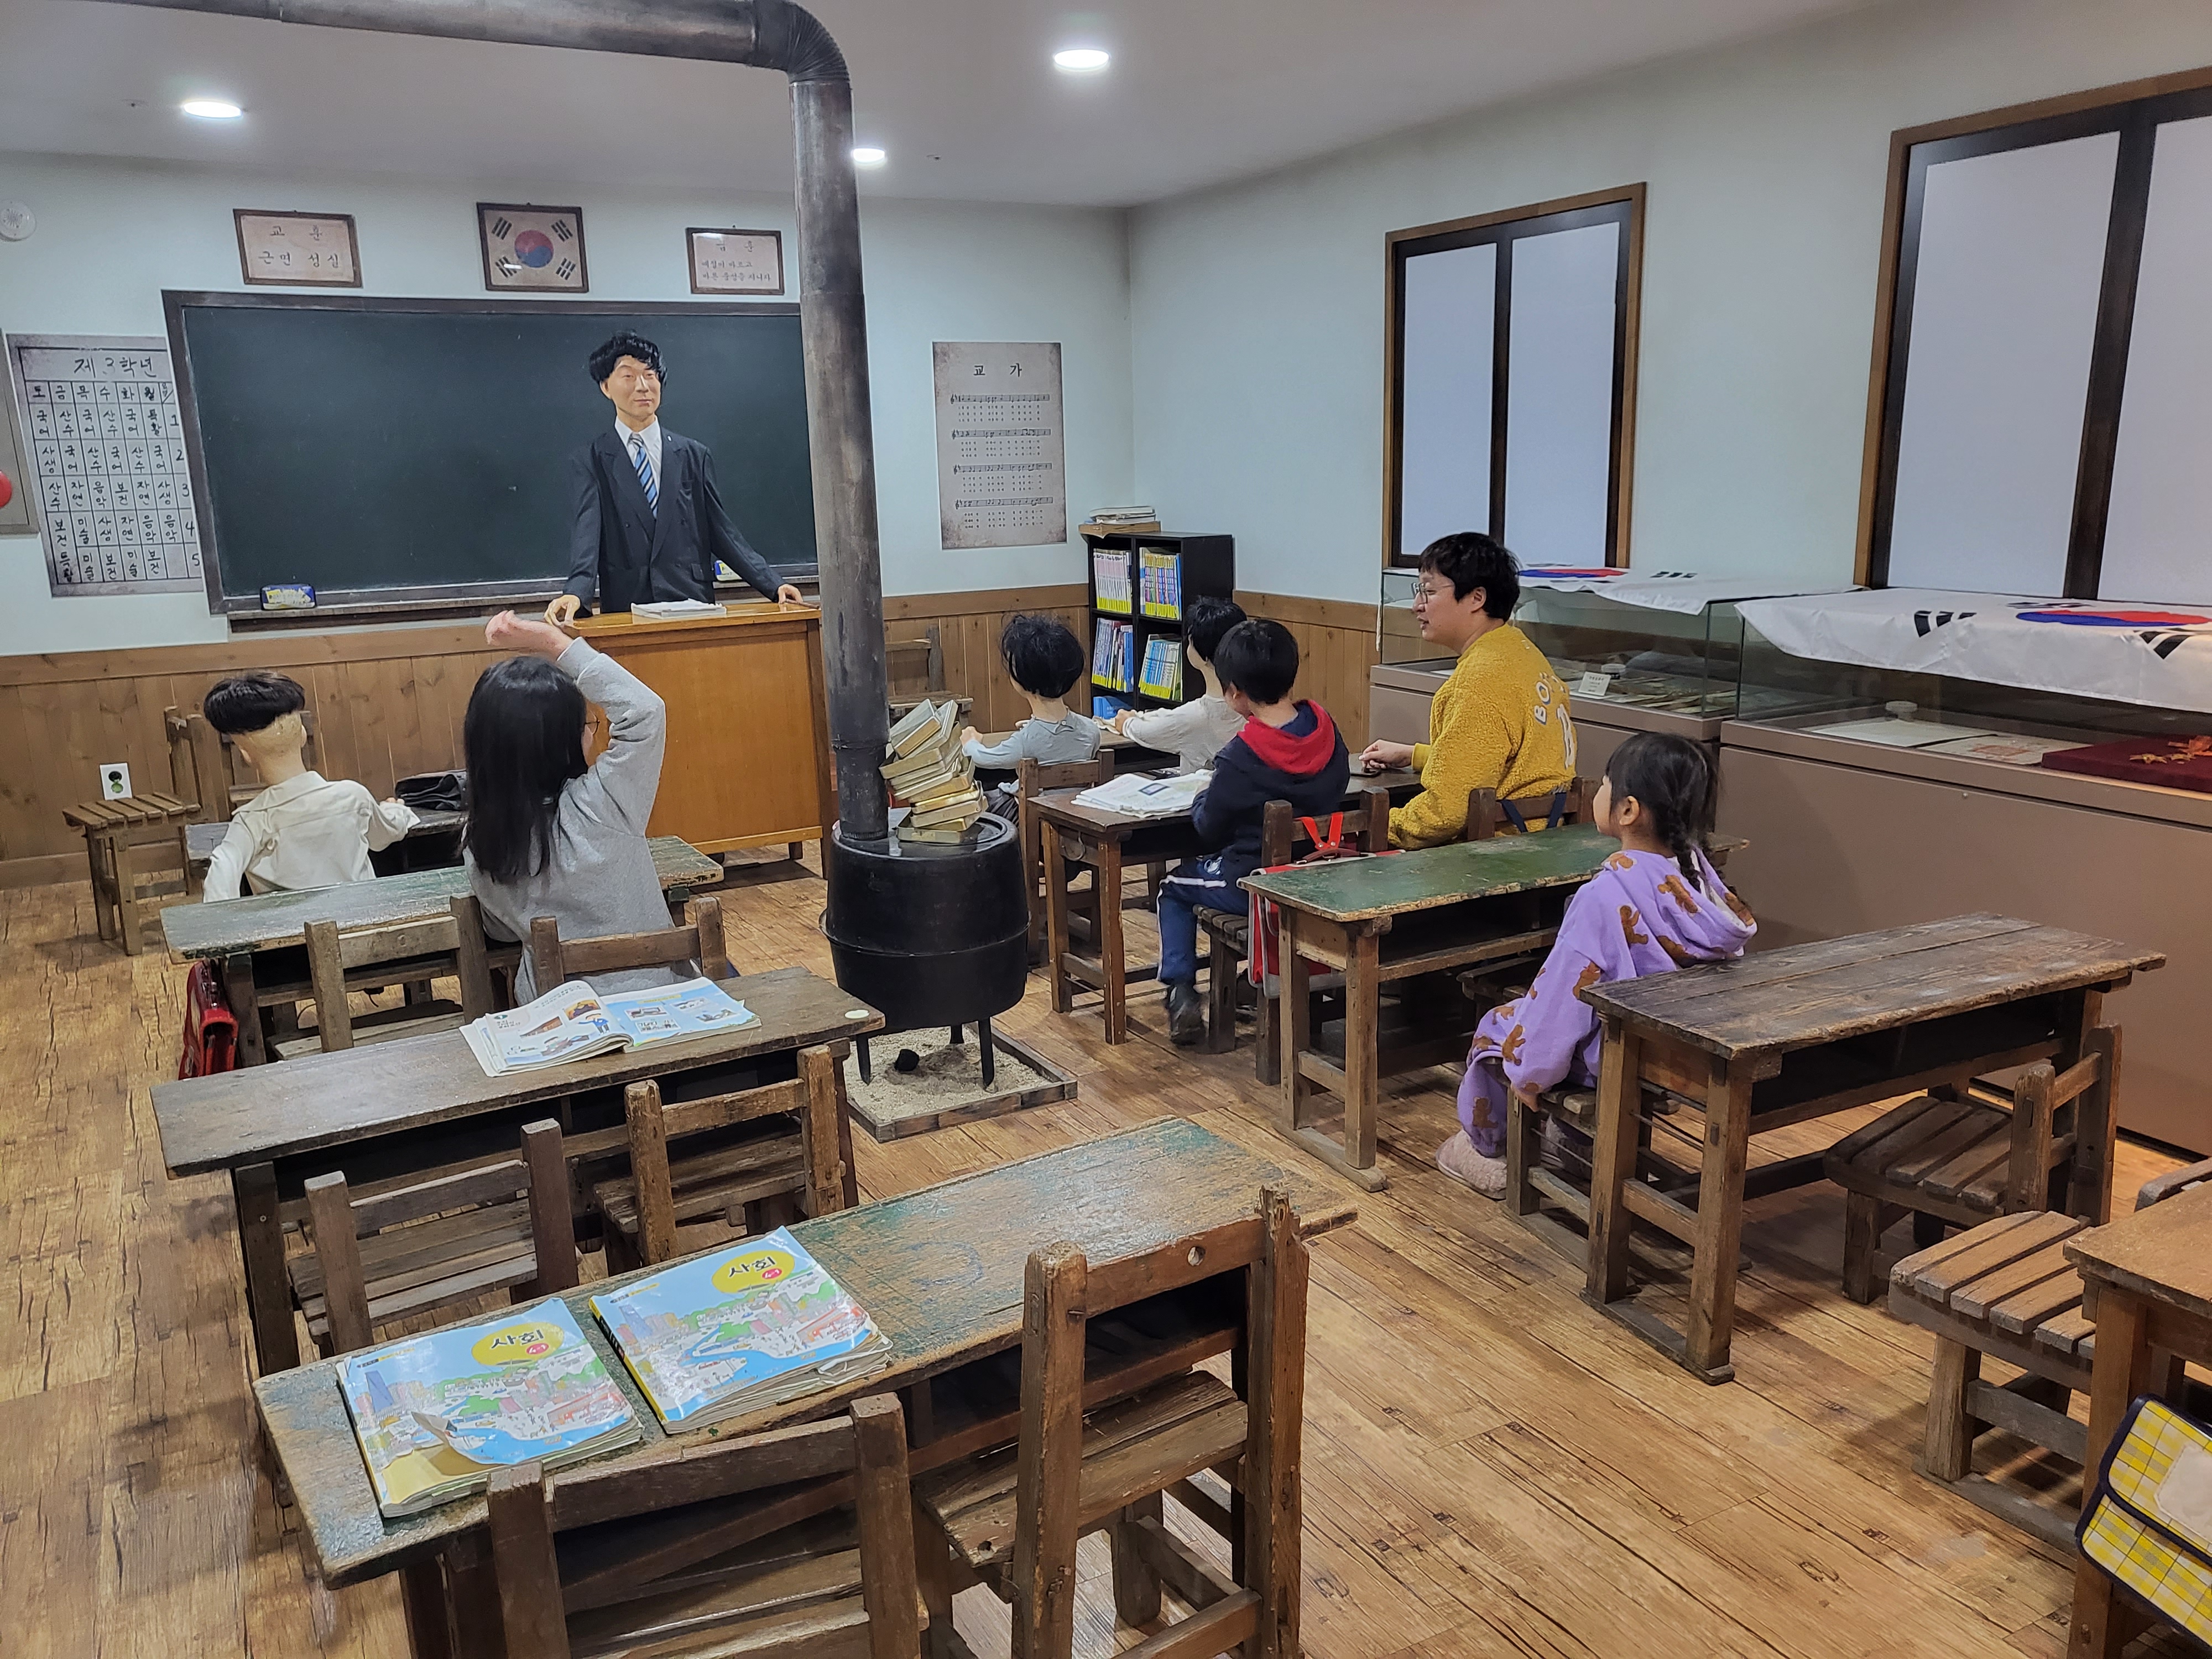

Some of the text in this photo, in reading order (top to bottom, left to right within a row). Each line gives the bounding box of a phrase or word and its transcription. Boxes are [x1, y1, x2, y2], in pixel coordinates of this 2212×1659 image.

[269, 225, 285, 236] 교
[258, 251, 291, 266] 근면
[973, 363, 1022, 378] 교 가
[32, 385, 46, 398] 토
[55, 384, 66, 400] 금
[76, 385, 90, 400] 목
[100, 385, 111, 401] 수
[121, 385, 135, 401] 화
[144, 386, 155, 401] 월
[36, 409, 50, 438] 국어
[59, 410, 74, 438] 산수
[82, 408, 96, 438] 국어
[103, 409, 118, 438] 산수
[125, 408, 139, 437] 국어
[170, 414, 180, 426] 1
[42, 444, 185, 474] 사생 국어 산수 국어 산수 국어 2
[48, 481, 62, 512] 산수
[71, 479, 85, 508] 자연
[92, 481, 107, 509] 음악
[137, 479, 150, 506] 자연
[157, 479, 171, 505] 사생
[181, 482, 190, 497] 3
[77, 516, 90, 545] 미술
[98, 515, 112, 541] 사생
[121, 515, 134, 541] 자연
[142, 514, 157, 544] 음악
[164, 514, 178, 542] 음악
[185, 520, 195, 537] 4
[82, 551, 95, 581] 미술
[127, 549, 138, 578] 미술
[191, 552, 200, 567] 5
[728, 1256, 776, 1278] 사회
[491, 1328, 544, 1349] 사회
